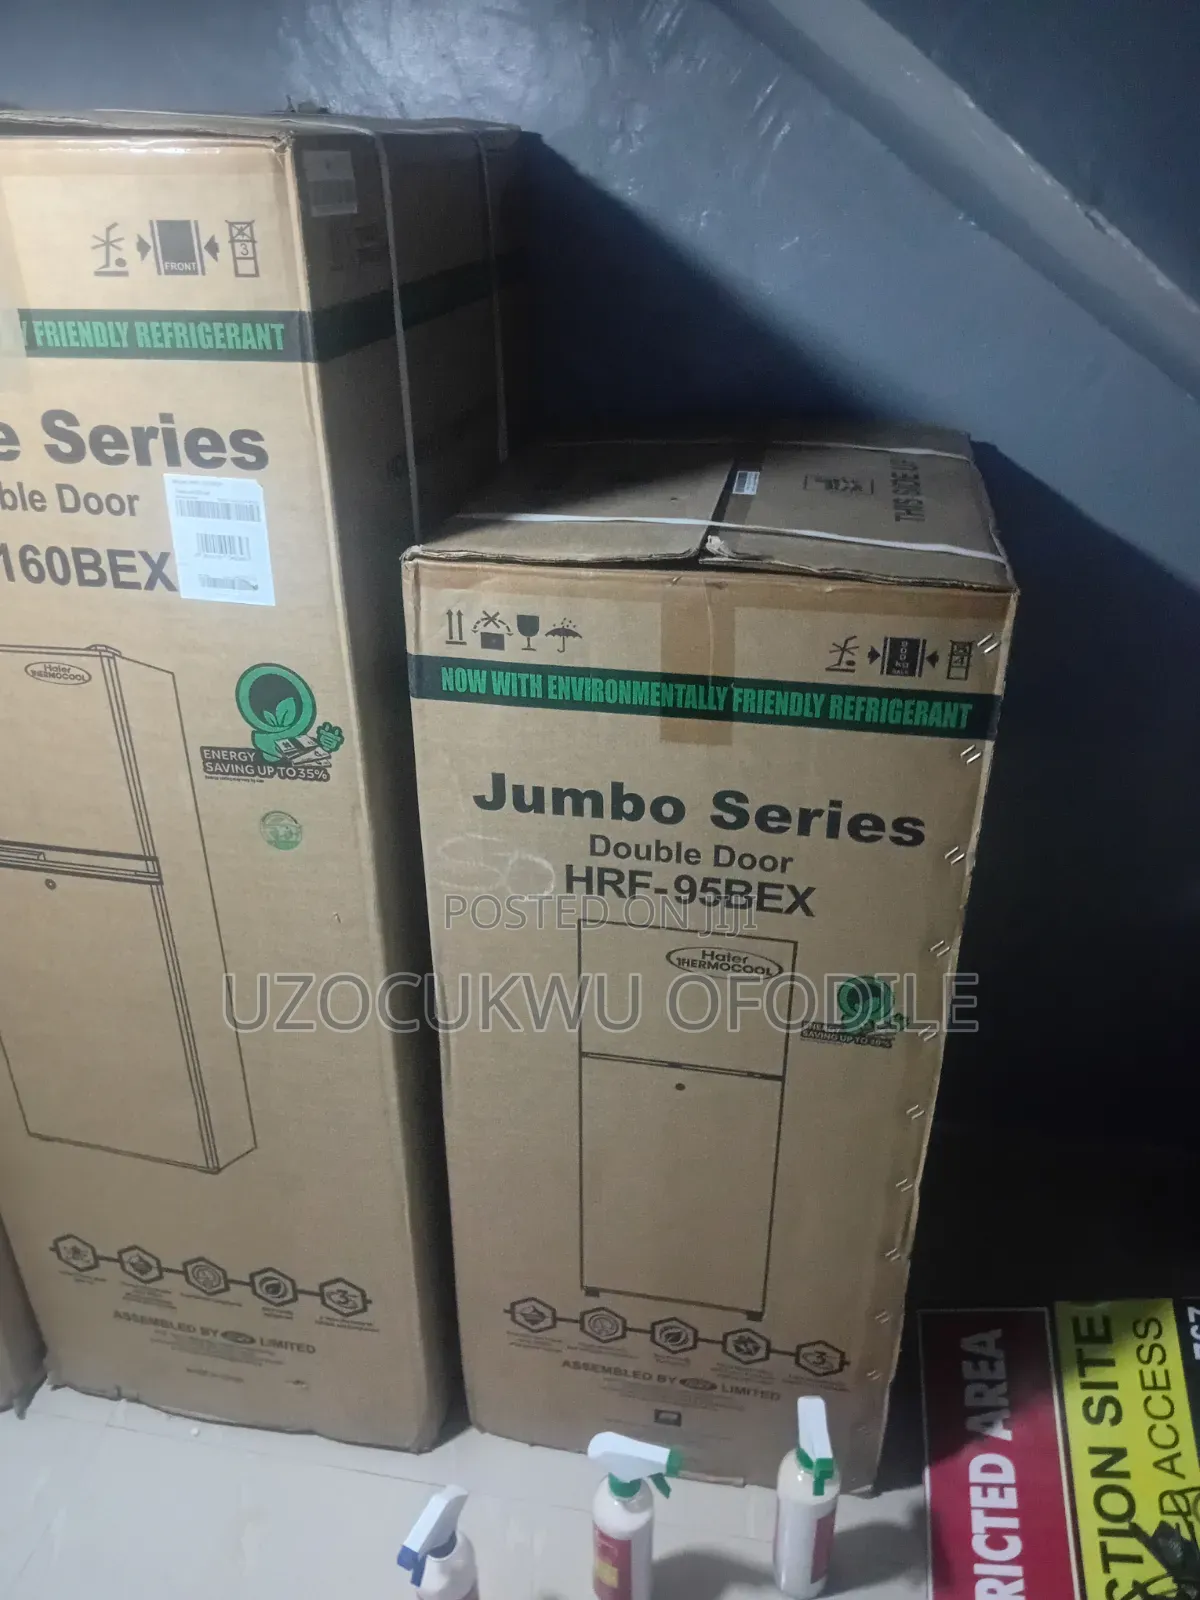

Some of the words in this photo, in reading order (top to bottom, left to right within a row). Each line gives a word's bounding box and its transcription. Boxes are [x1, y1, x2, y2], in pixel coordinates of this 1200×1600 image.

[164, 261, 198, 273] FRONT
[33, 320, 129, 348] FRIENDLY
[135, 321, 285, 351] REFRIGERANT
[41, 409, 269, 471] Series
[55, 483, 140, 517] Door
[441, 666, 487, 694] NOW
[491, 670, 543, 699] WITH
[547, 675, 727, 711] ENVIRONMENTALLY
[732, 686, 825, 719] FRIENDLY
[828, 693, 972, 730] REFRIGERANT
[203, 749, 256, 762] ENERGY
[205, 761, 255, 775] SAVING
[257, 765, 275, 776] UP
[277, 766, 297, 777] TO
[298, 768, 328, 780] 35%
[472, 772, 686, 825] Jumbo
[709, 788, 926, 847] Series
[589, 833, 701, 866] Double
[713, 845, 793, 874] Door
[564, 864, 817, 917] HRF-95BEX
[676, 957, 773, 977] THERMOCOOL
[701, 949, 748, 964] Haier
[803, 1029, 838, 1042] SAVING
[113, 1310, 196, 1334] ASSEMBLED
[200, 1326, 220, 1337] BY
[259, 1337, 316, 1354] LIMITED
[562, 1359, 653, 1382] ASSEMBLED
[656, 1374, 679, 1385] BY
[720, 1385, 781, 1402] LIMITED
[960, 1328, 1013, 1441] AREA
[1071, 1315, 1123, 1427] SITE
[1132, 1317, 1186, 1480] ACCESS
[968, 1453, 1026, 1600] RICTED
